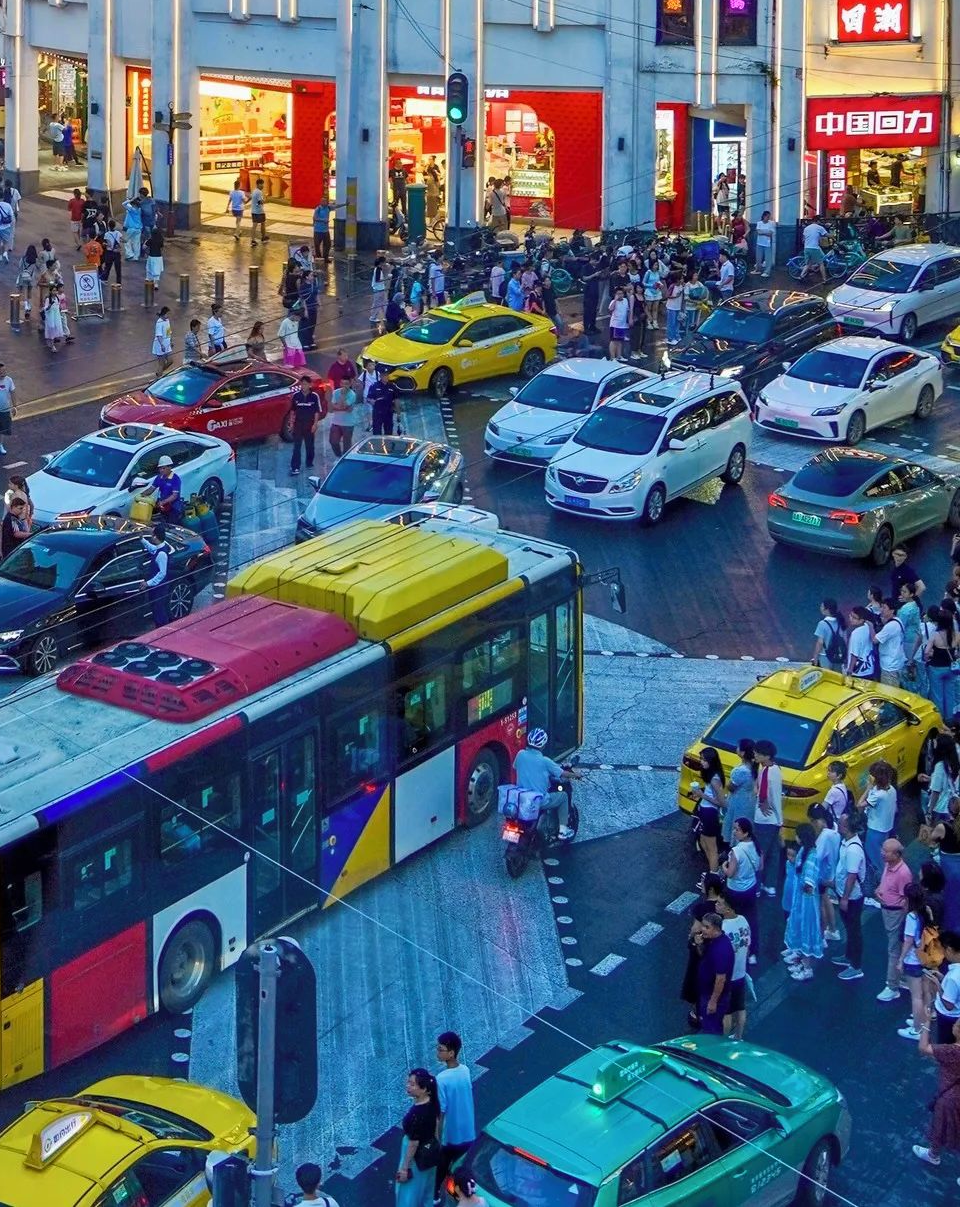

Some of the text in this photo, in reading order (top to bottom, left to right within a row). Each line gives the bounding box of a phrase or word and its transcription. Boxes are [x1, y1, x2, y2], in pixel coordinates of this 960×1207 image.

[815, 109, 933, 137] 中国回力
[829, 155, 846, 204] 中国回力
